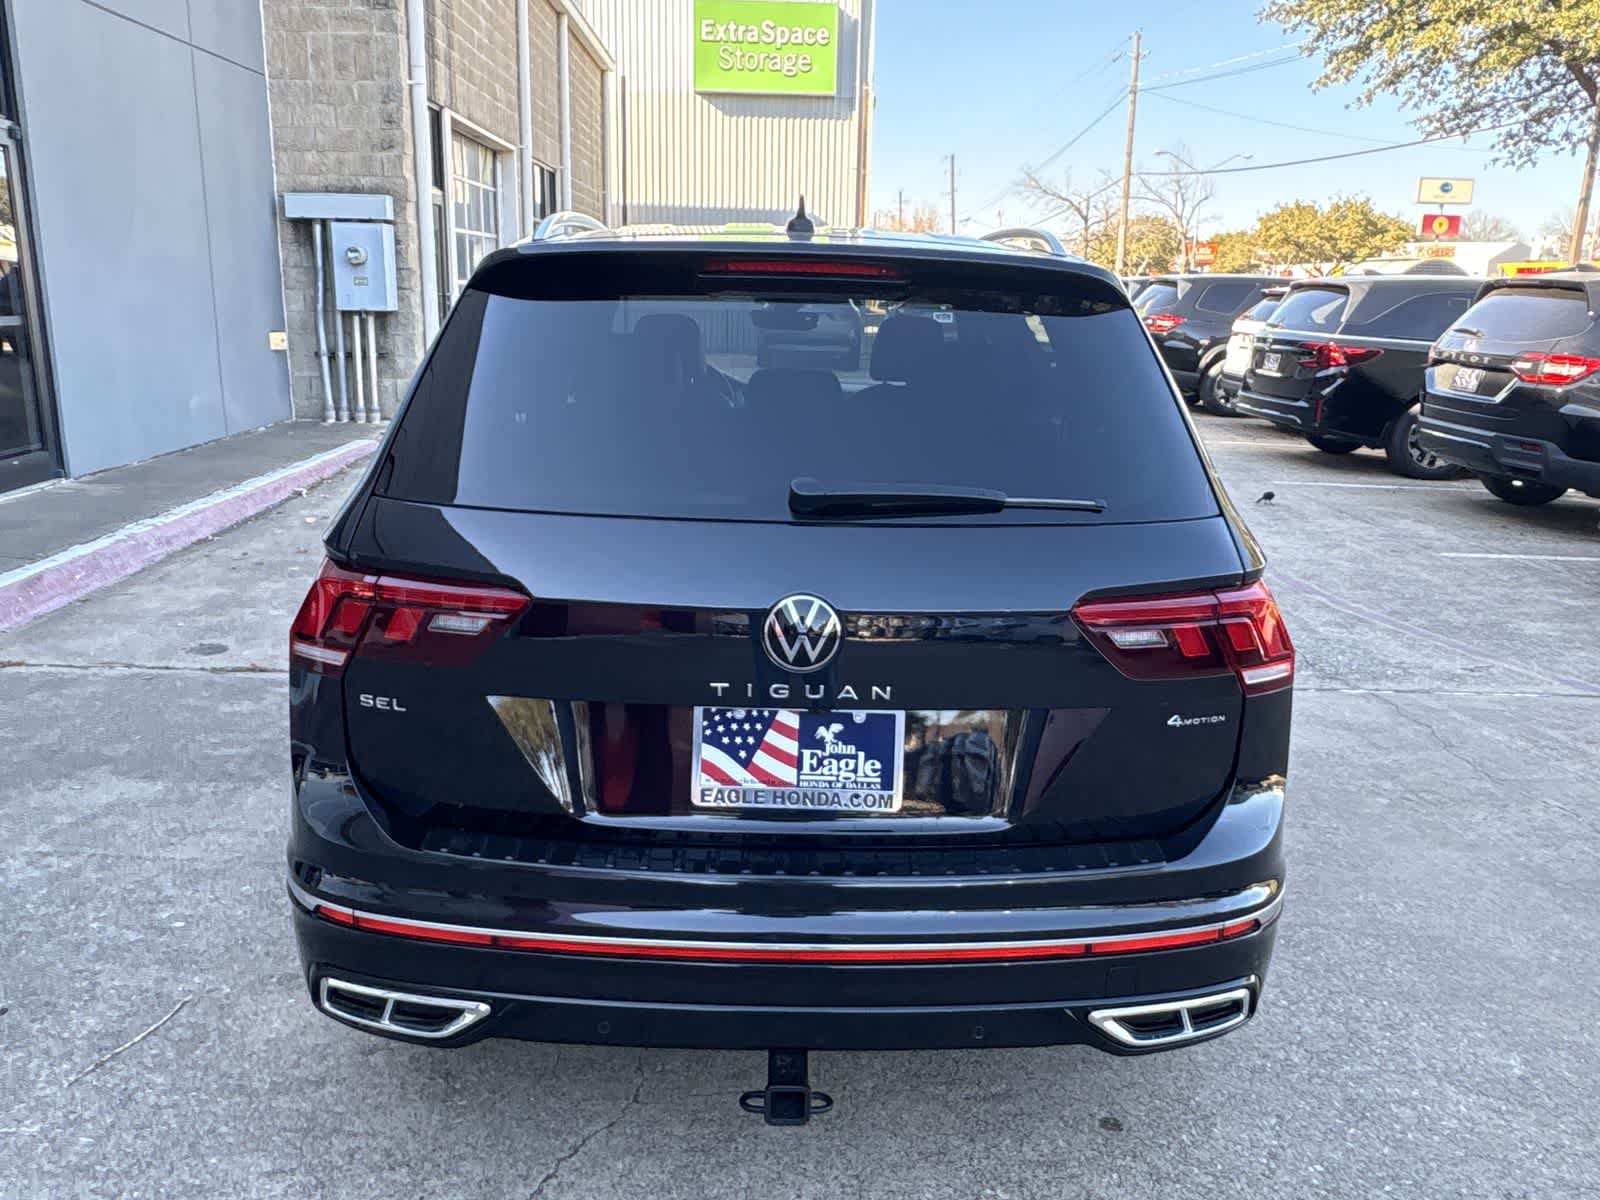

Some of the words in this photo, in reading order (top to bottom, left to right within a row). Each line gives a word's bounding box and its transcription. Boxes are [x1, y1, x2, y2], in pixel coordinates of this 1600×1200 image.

[719, 46, 813, 77] Storage
[710, 682, 892, 700] TIGUAN
[359, 693, 407, 712] SEL
[1167, 713, 1226, 728] 4MOTION
[822, 741, 857, 756] John
[800, 749, 882, 782] Eagle
[700, 788, 766, 804] EAGLE
[772, 790, 894, 809] HONDA.COM
